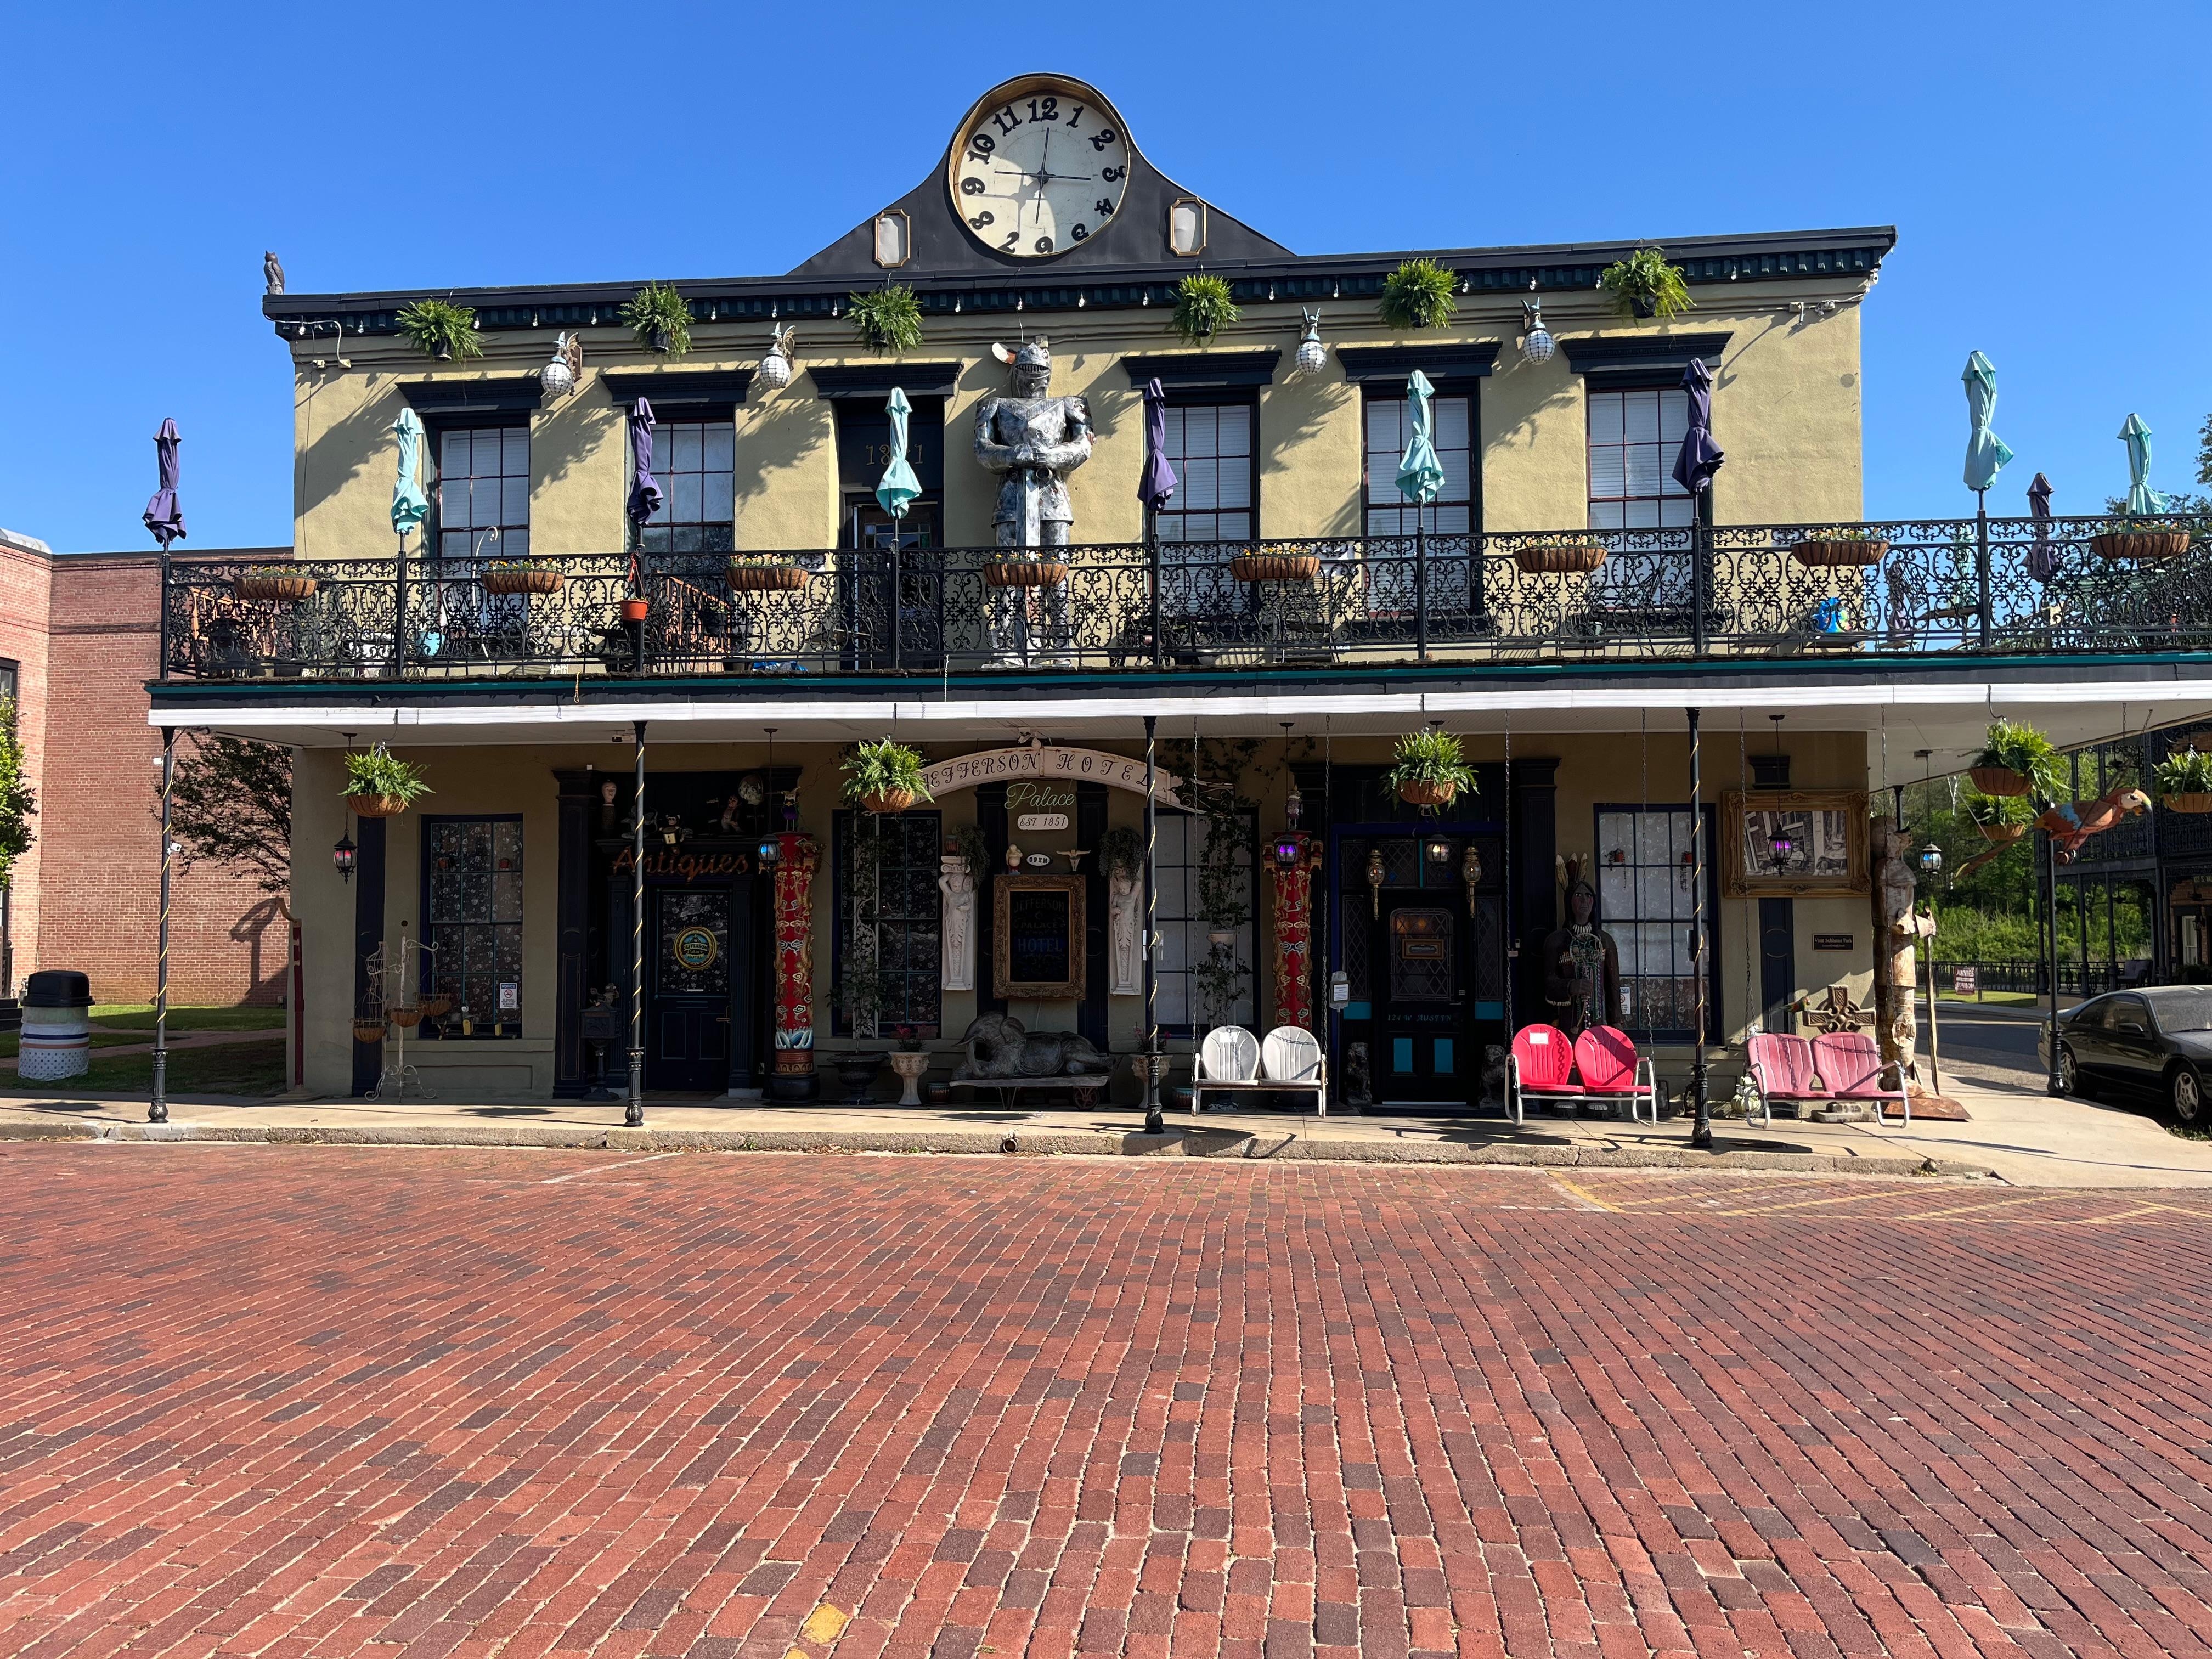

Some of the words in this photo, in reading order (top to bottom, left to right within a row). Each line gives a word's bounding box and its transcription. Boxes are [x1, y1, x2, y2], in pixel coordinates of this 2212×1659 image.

[1027, 97, 1059, 123] 12
[1066, 105, 1084, 128] 1
[992, 106, 1023, 137] 11
[967, 133, 996, 165] 10
[1088, 129, 1116, 151] 2
[968, 211, 995, 230] 8
[865, 444, 923, 465] 181
[1005, 782, 1075, 809] Palace
[1043, 817, 1065, 826] 1851
[611, 845, 749, 883] Antiques
[1013, 898, 1064, 913] JEFFERSON
[1018, 938, 1063, 953] HOTEL
